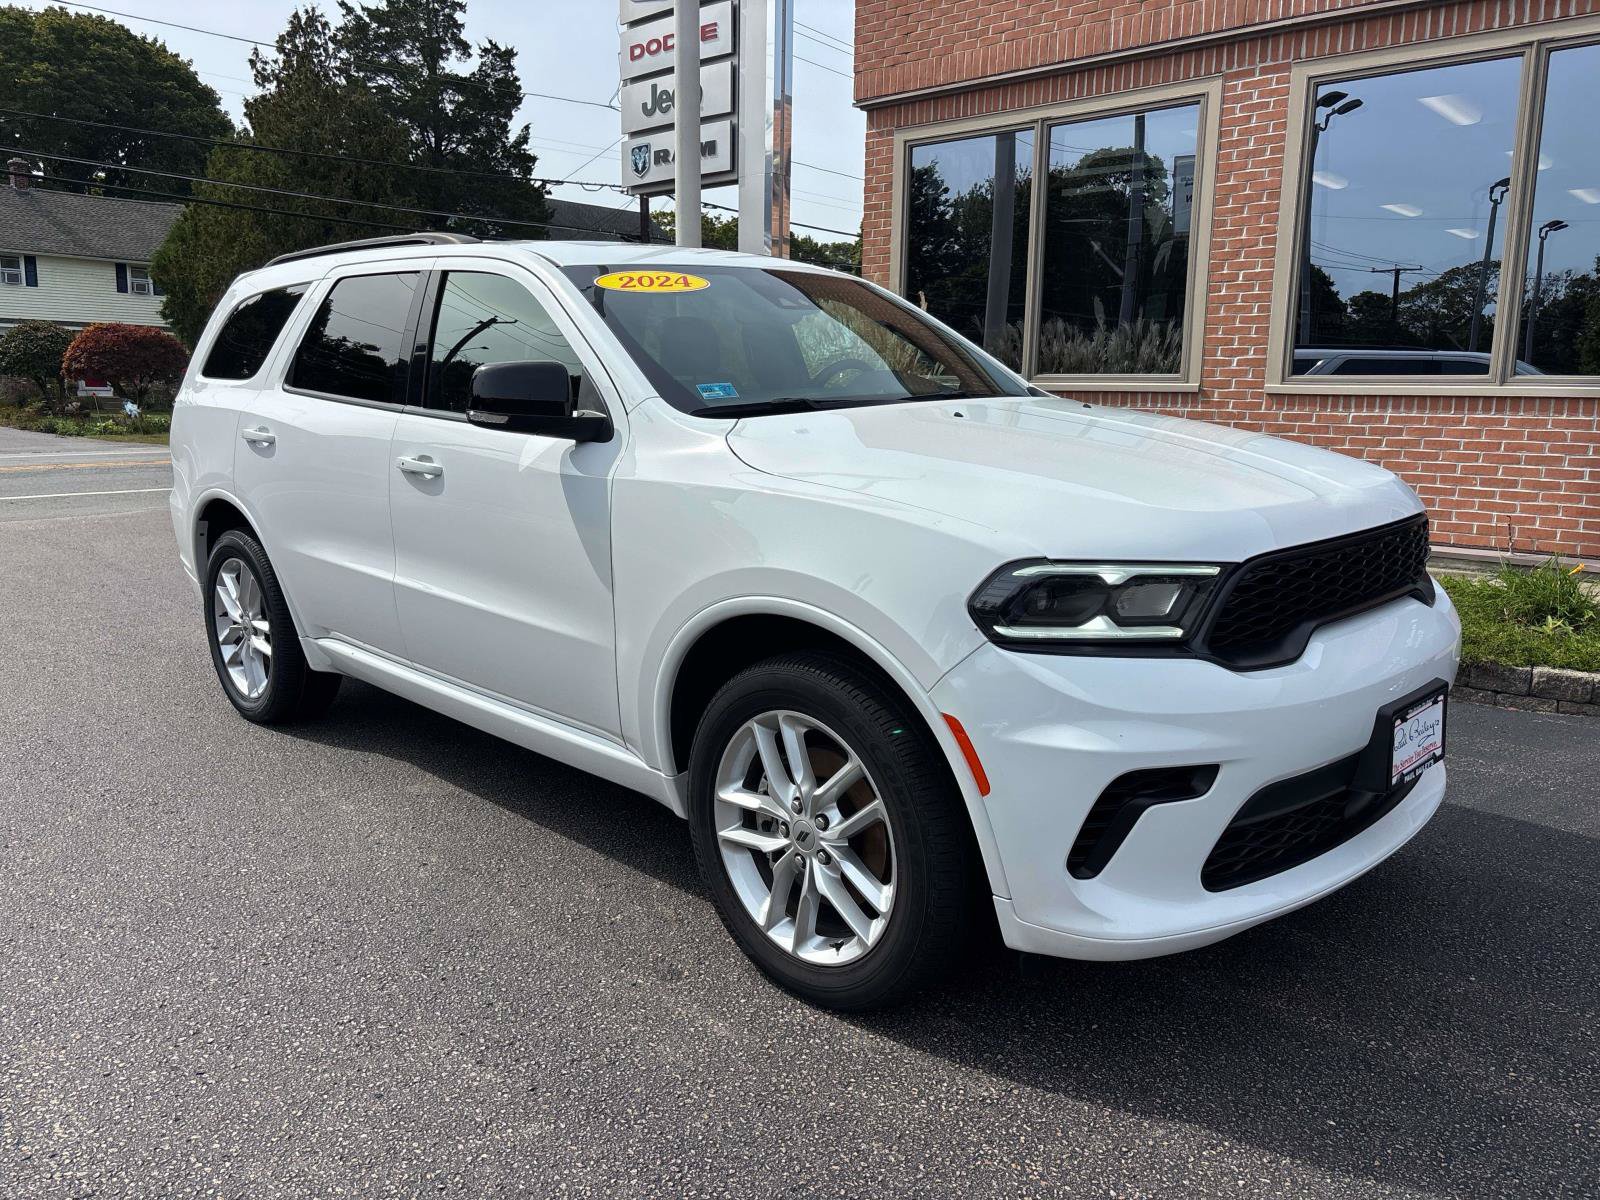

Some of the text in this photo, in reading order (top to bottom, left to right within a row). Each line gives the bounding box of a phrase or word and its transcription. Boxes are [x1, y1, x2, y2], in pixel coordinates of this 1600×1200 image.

[629, 22, 718, 62] DODE
[641, 83, 703, 117] Je
[653, 139, 717, 166] RM
[618, 275, 693, 288] 2024
